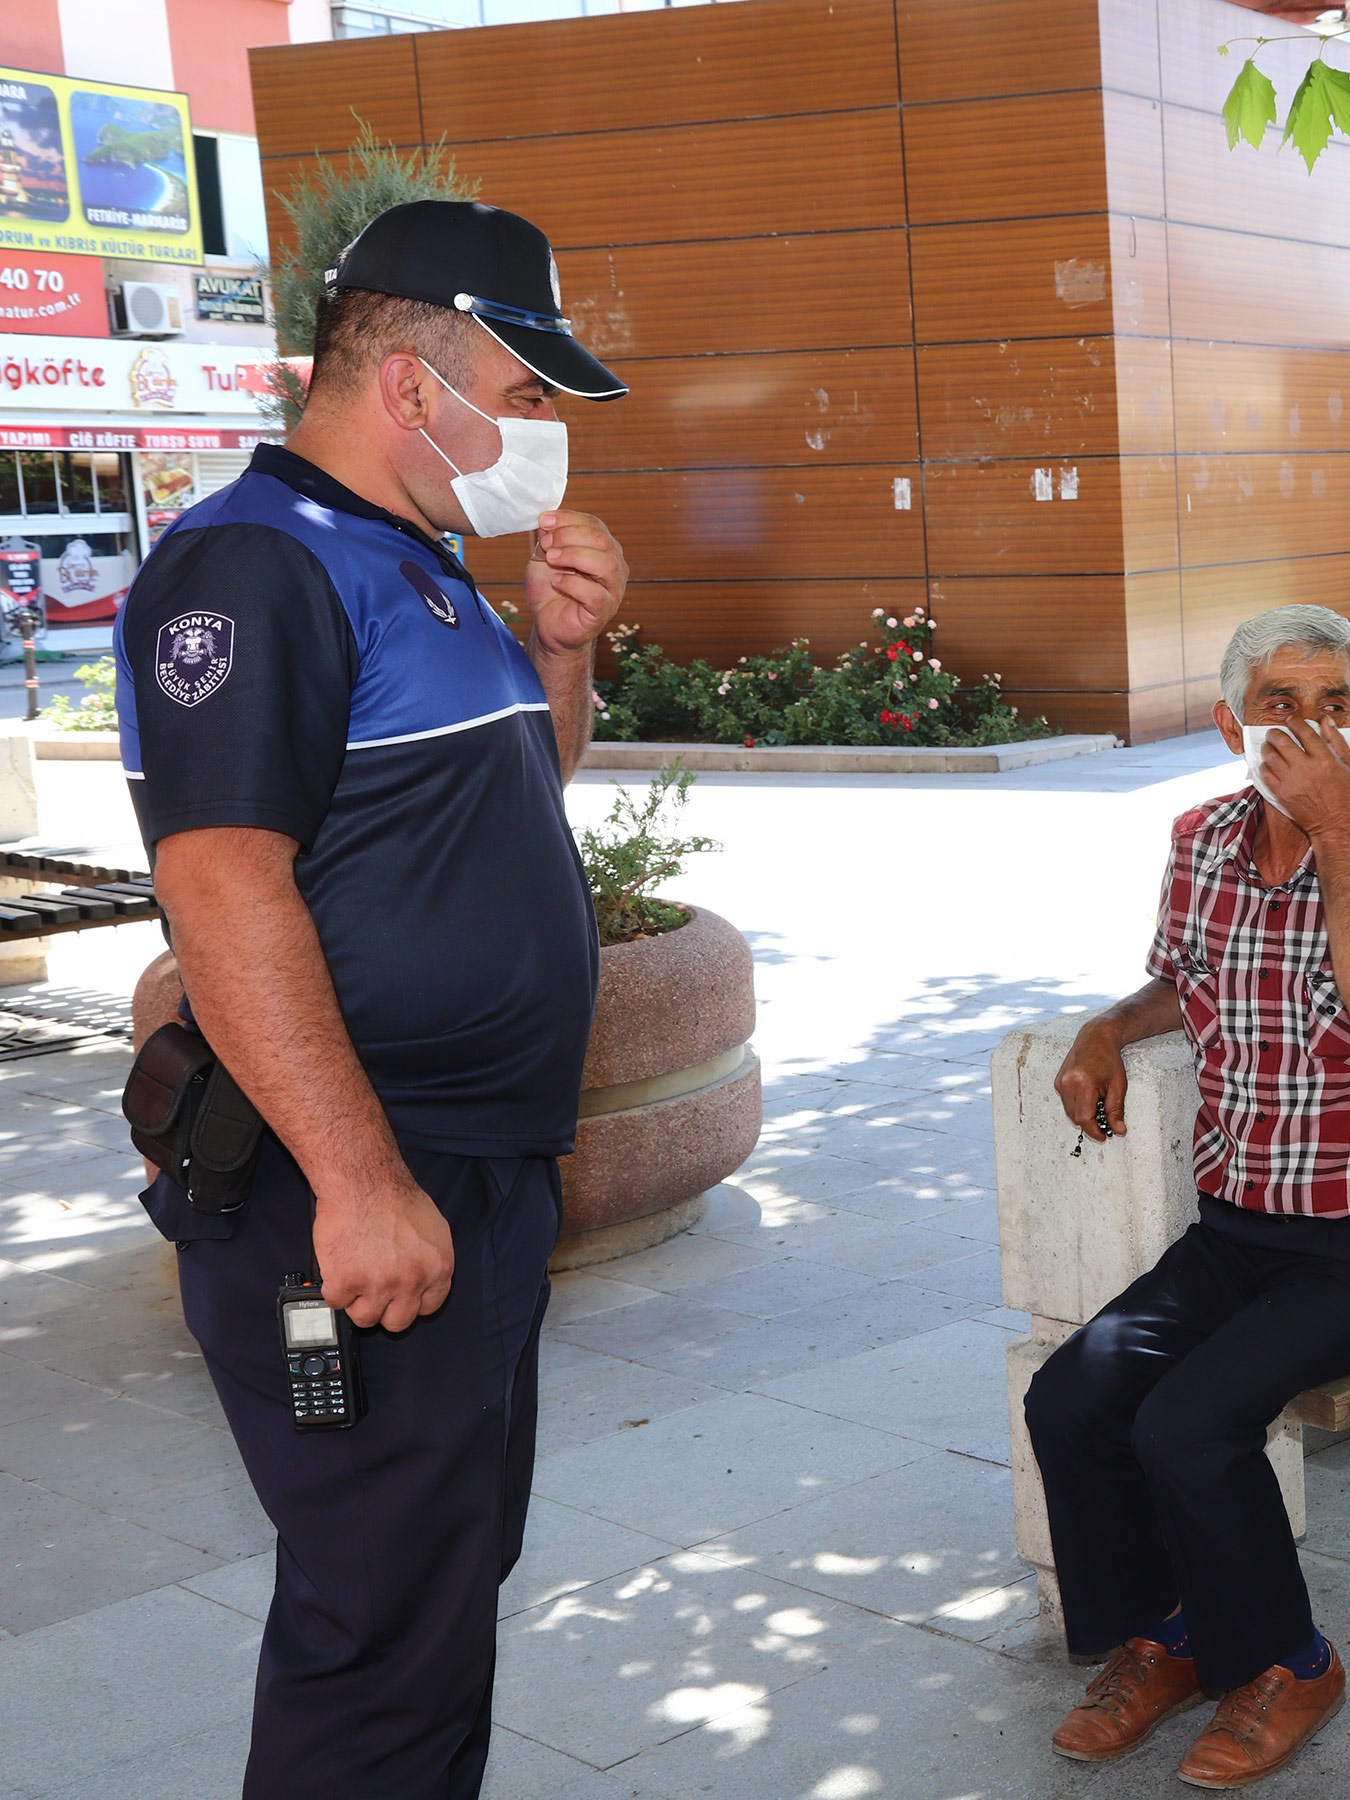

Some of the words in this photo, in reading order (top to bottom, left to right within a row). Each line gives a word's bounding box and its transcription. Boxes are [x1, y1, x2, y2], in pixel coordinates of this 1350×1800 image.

[0, 83, 28, 101] ARA
[38, 237, 51, 247] ve
[55, 235, 97, 252] KIBRIS
[101, 237, 145, 256] KÜLTÜR
[149, 244, 197, 261] TURLARI
[0, 267, 29, 290] 40
[33, 269, 64, 292] 70
[197, 277, 261, 297] AVUKAT
[0, 431, 51, 446] YAPIMI
[96, 431, 136, 448] KÖFTE
[169, 616, 222, 635] KONYA
[160, 663, 192, 702] BELEDİYE
[192, 657, 228, 701] ZABITASI
[167, 662, 191, 691] BÜYÜK
[194, 658, 218, 689] ŞEHİR
[298, 1301, 319, 1309] Hytera
